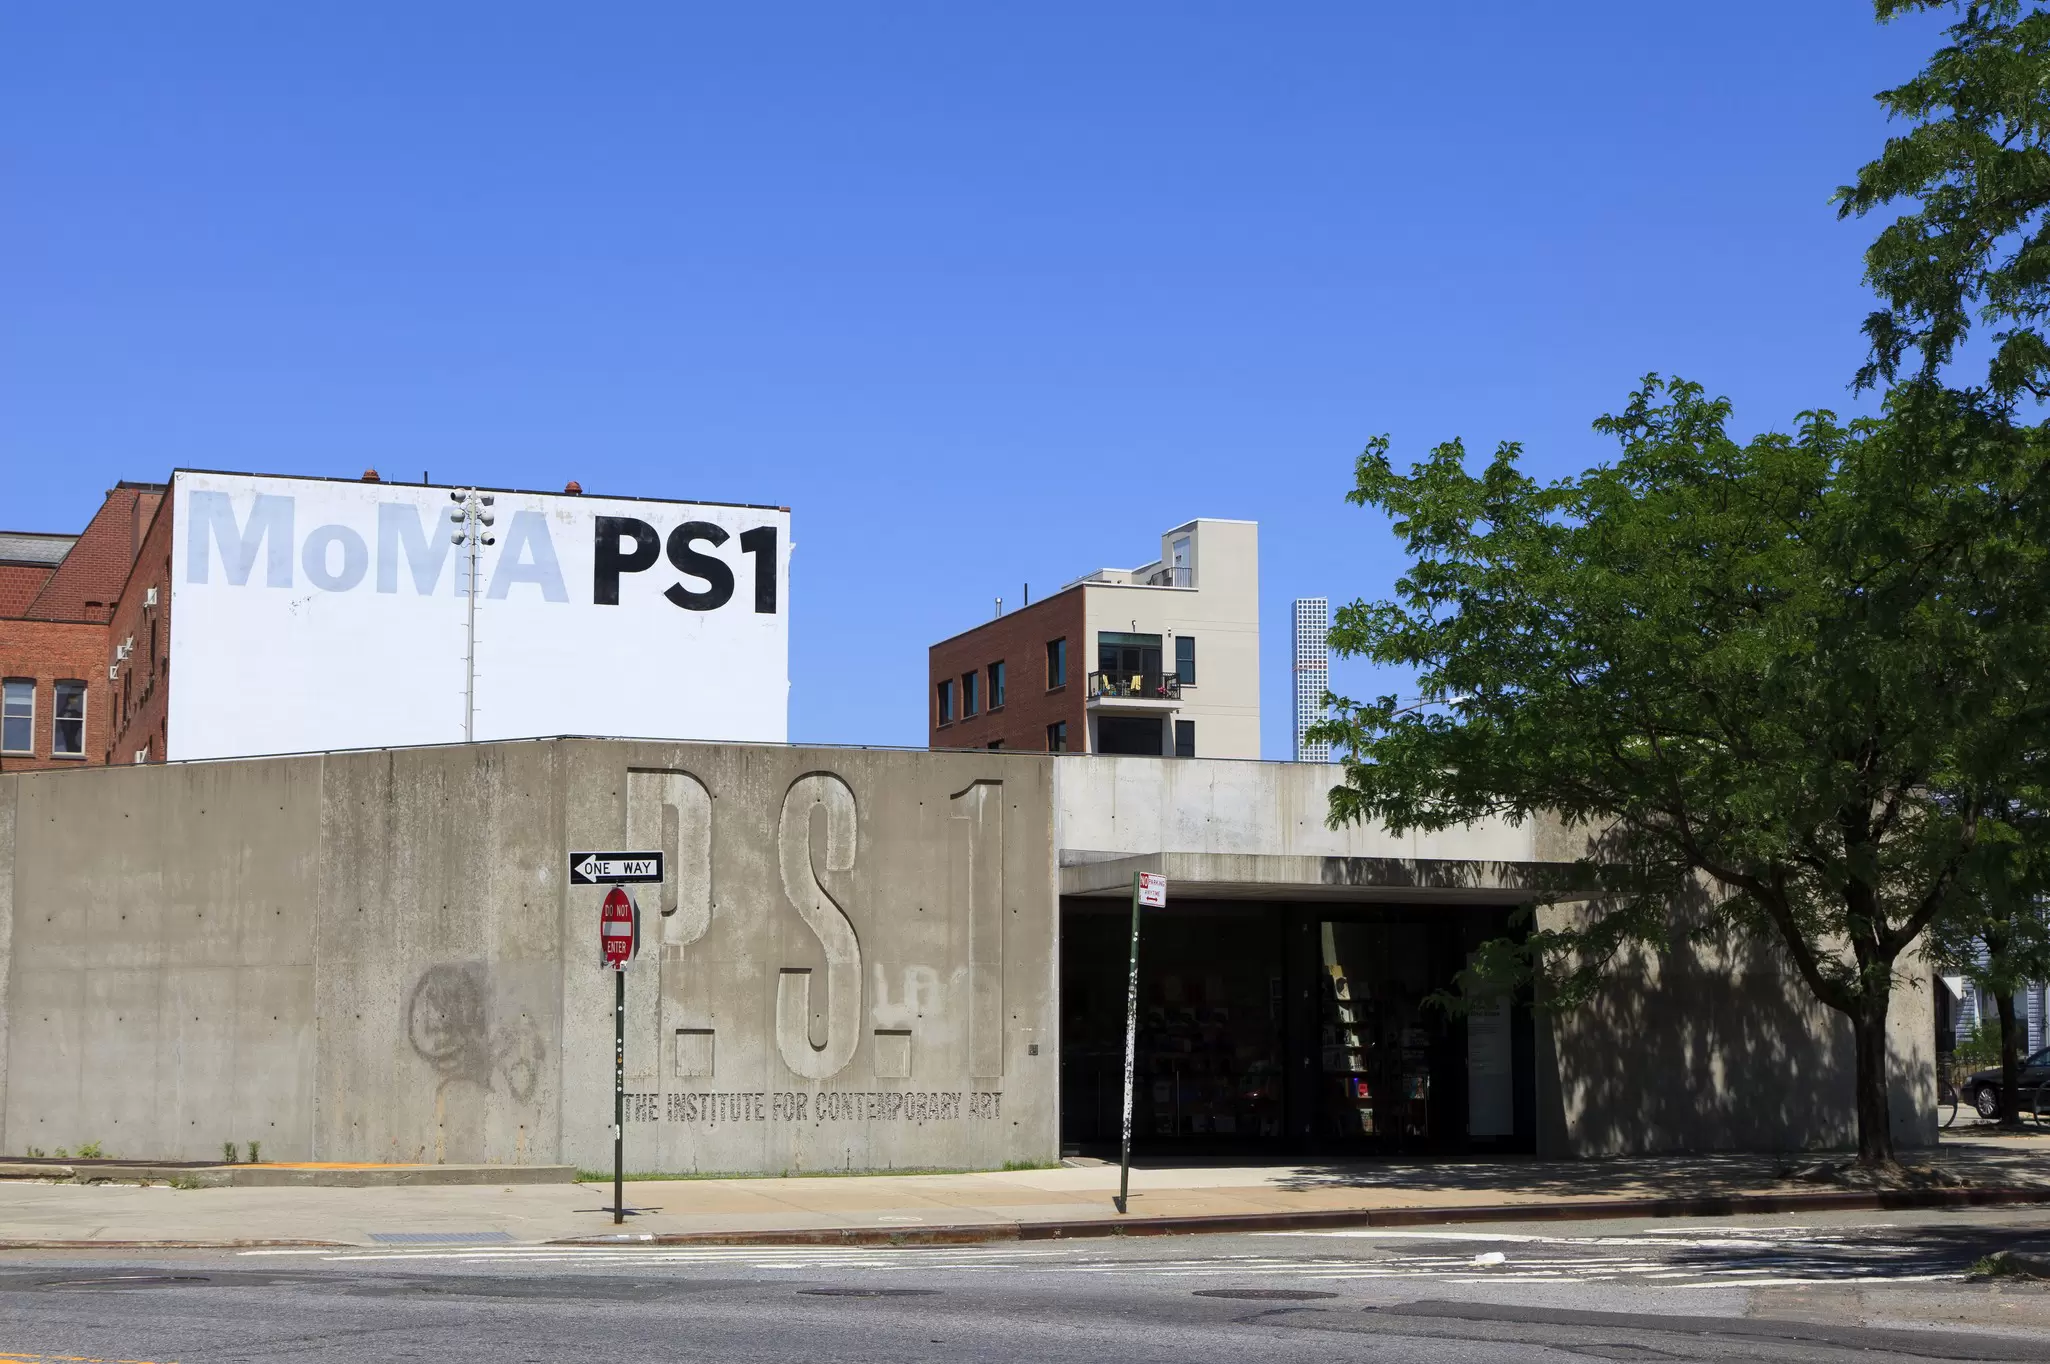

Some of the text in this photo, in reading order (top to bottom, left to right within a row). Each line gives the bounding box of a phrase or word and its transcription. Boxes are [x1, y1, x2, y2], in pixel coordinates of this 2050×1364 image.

[186, 490, 777, 614] MoMA PS1
[584, 861, 651, 875] ONE WAY
[605, 904, 628, 917] DO NOT
[607, 941, 626, 953] ENTER
[623, 1092, 1002, 1122] THE INSTITUTE FOR CONTEMPORARY ART
